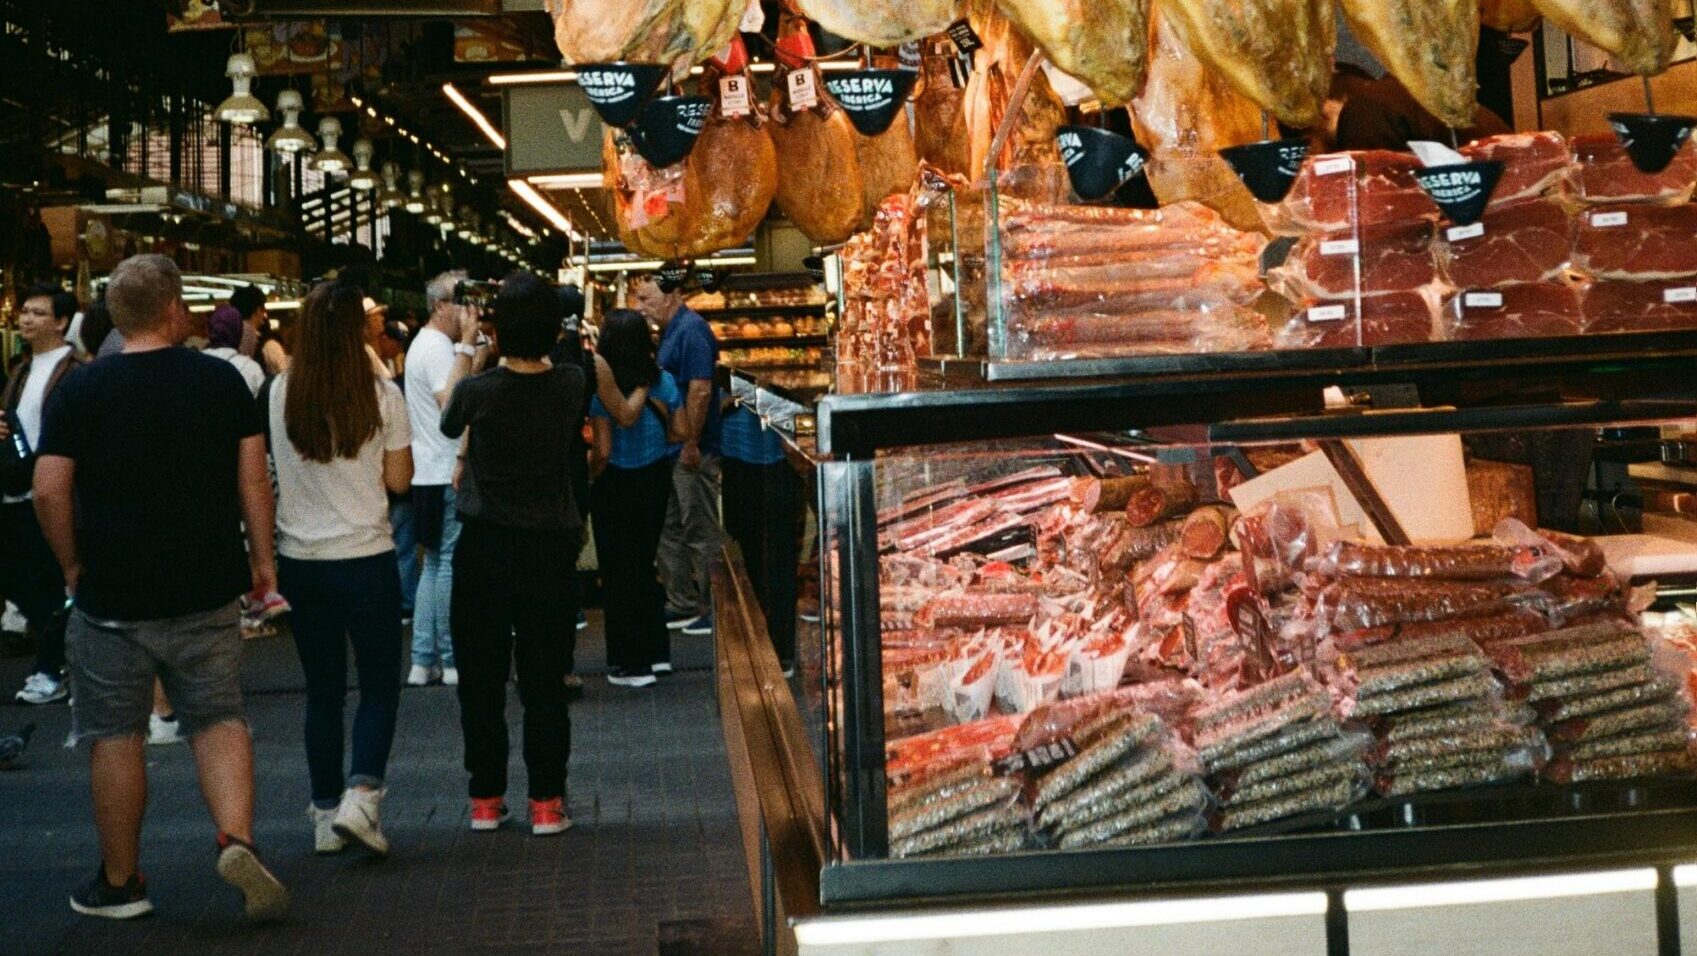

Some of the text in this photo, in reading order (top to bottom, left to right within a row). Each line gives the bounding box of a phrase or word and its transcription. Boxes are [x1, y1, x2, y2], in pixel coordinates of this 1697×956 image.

[728, 80, 738, 92] B
[796, 74, 805, 86] B
[559, 109, 593, 143] V
